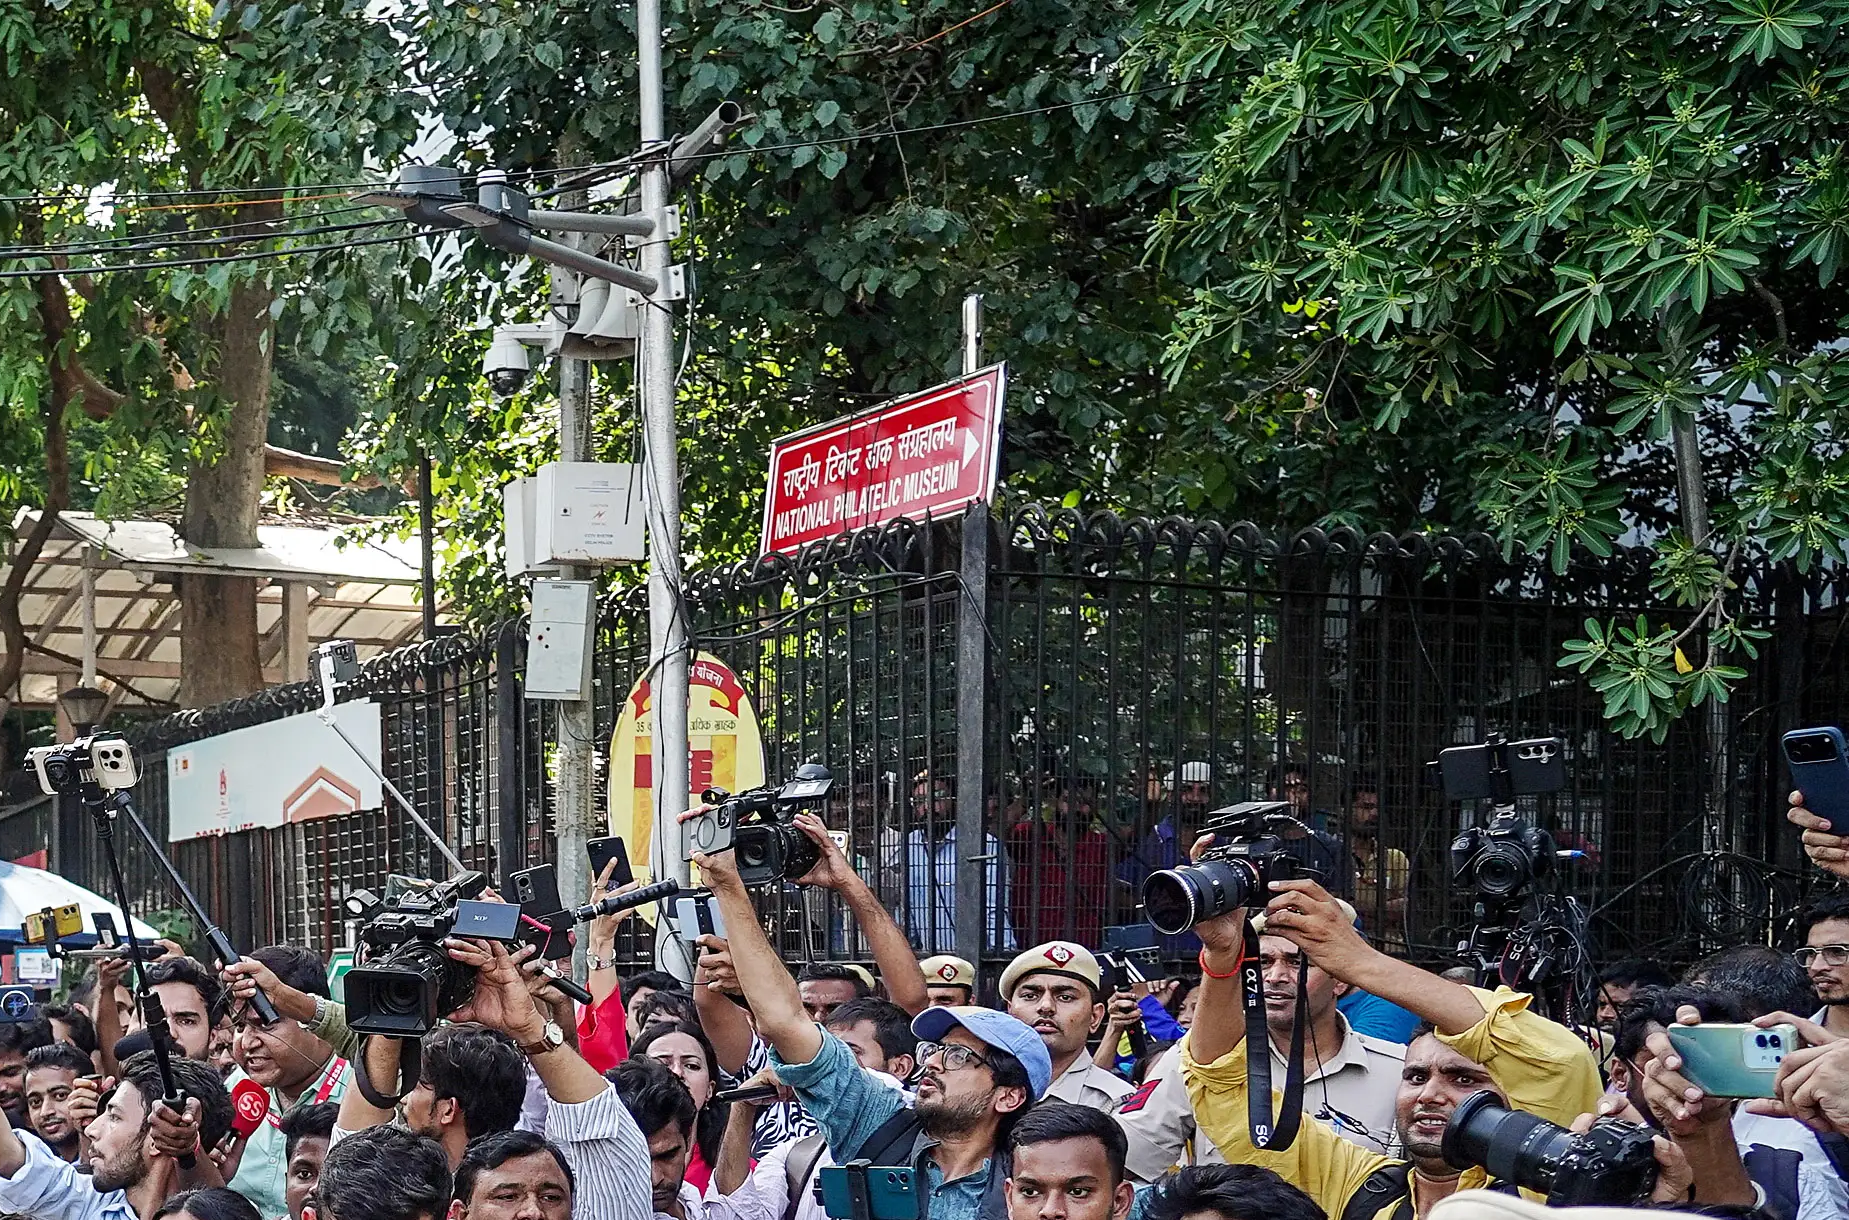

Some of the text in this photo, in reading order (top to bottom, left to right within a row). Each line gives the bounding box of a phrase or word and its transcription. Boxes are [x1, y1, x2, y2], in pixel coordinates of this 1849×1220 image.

[897, 416, 958, 460] संग्रहालय
[774, 460, 960, 540] NATIONAL PHILATELIC MUSEUM
[696, 664, 725, 687] योजना
[636, 723, 645, 732] 35
